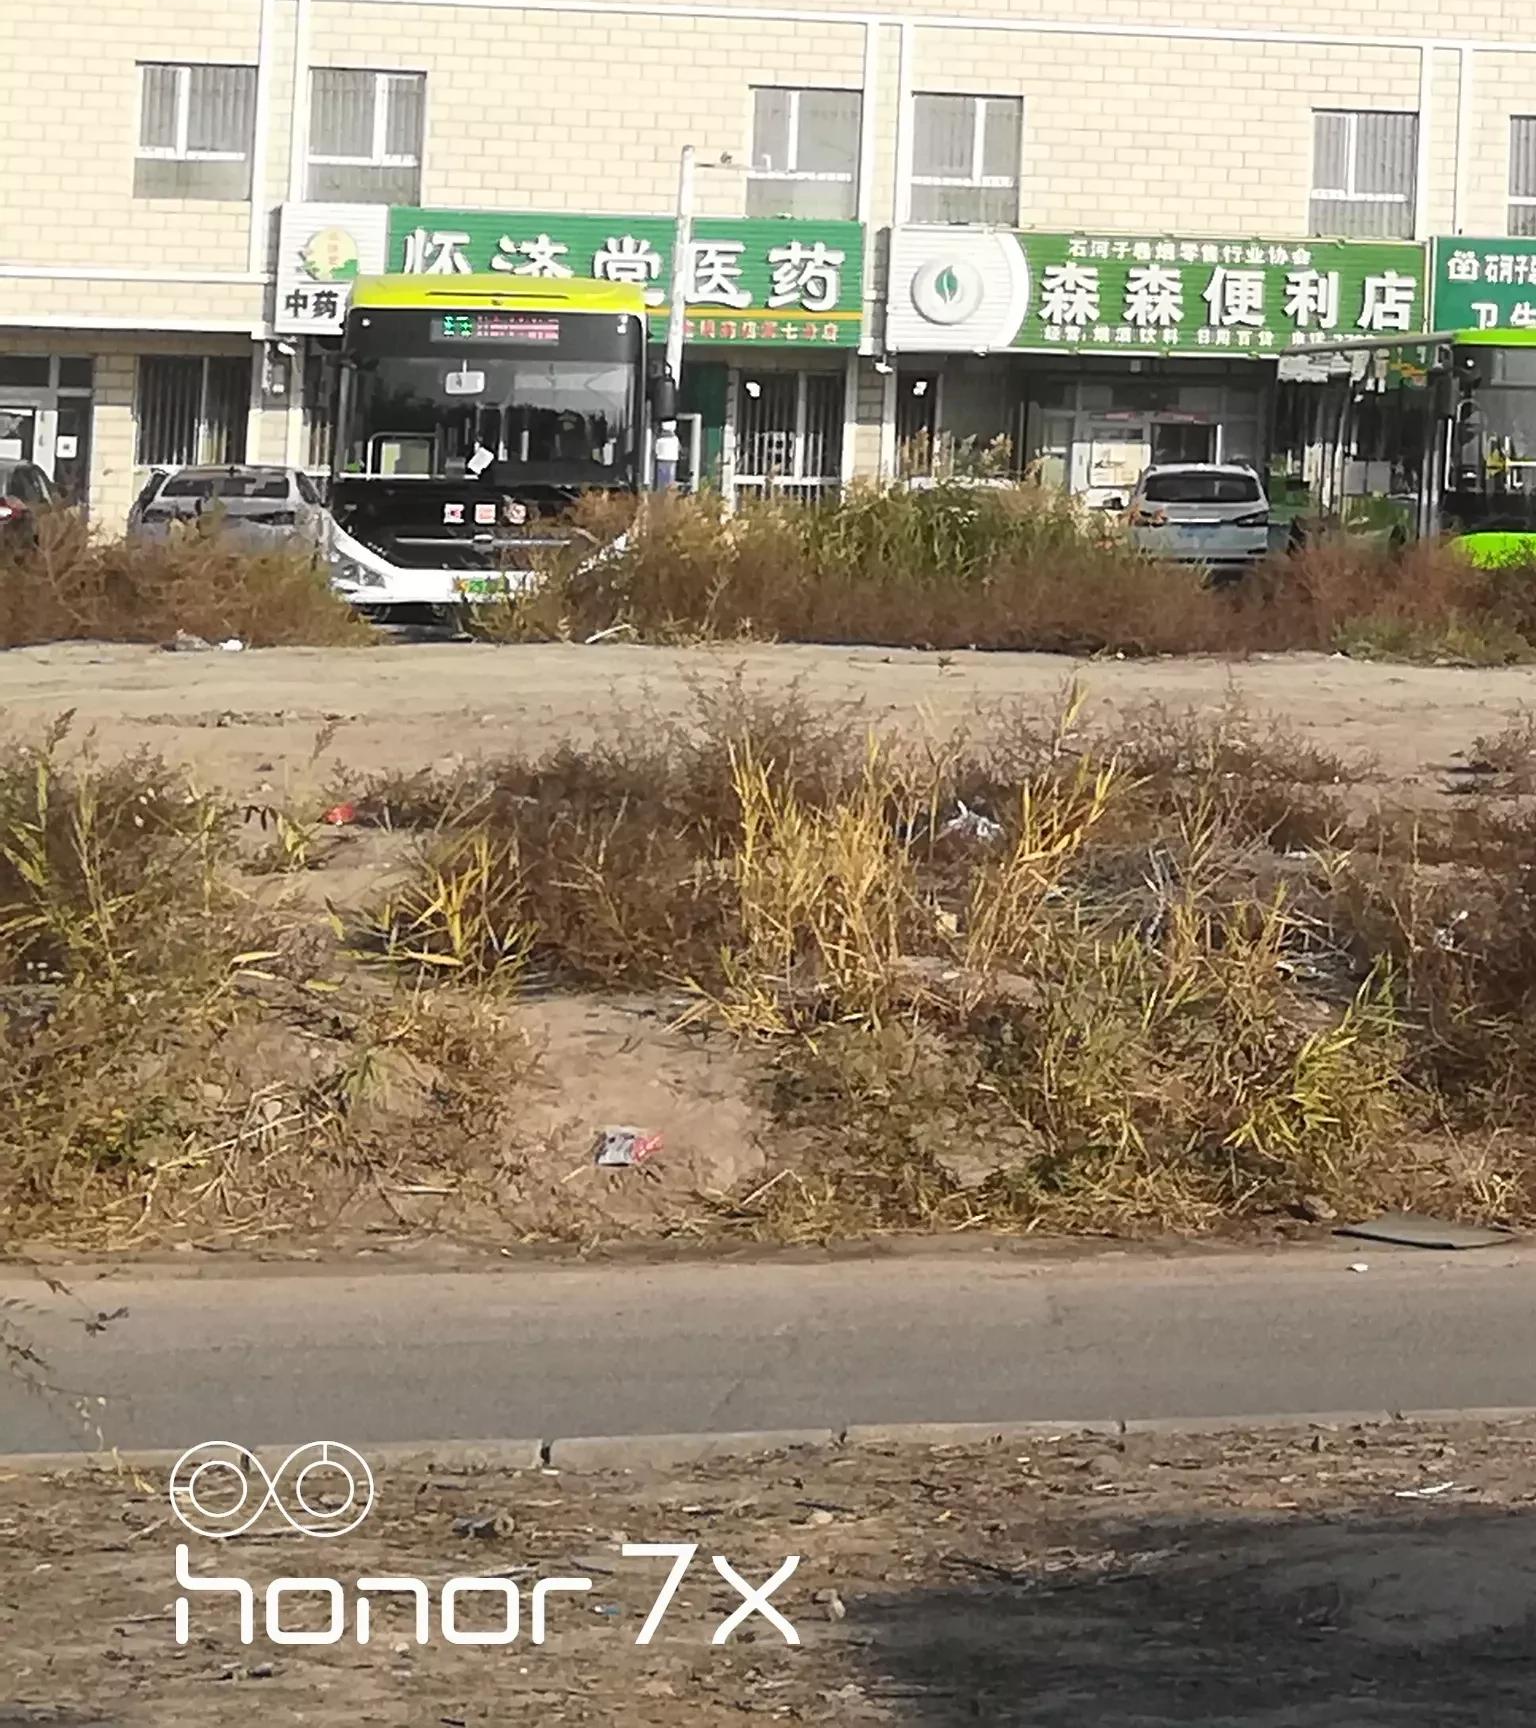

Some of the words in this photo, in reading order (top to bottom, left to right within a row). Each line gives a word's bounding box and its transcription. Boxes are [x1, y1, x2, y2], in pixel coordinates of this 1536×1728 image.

[285, 288, 338, 320] 中药
[1038, 261, 1418, 331] 森森便利店
